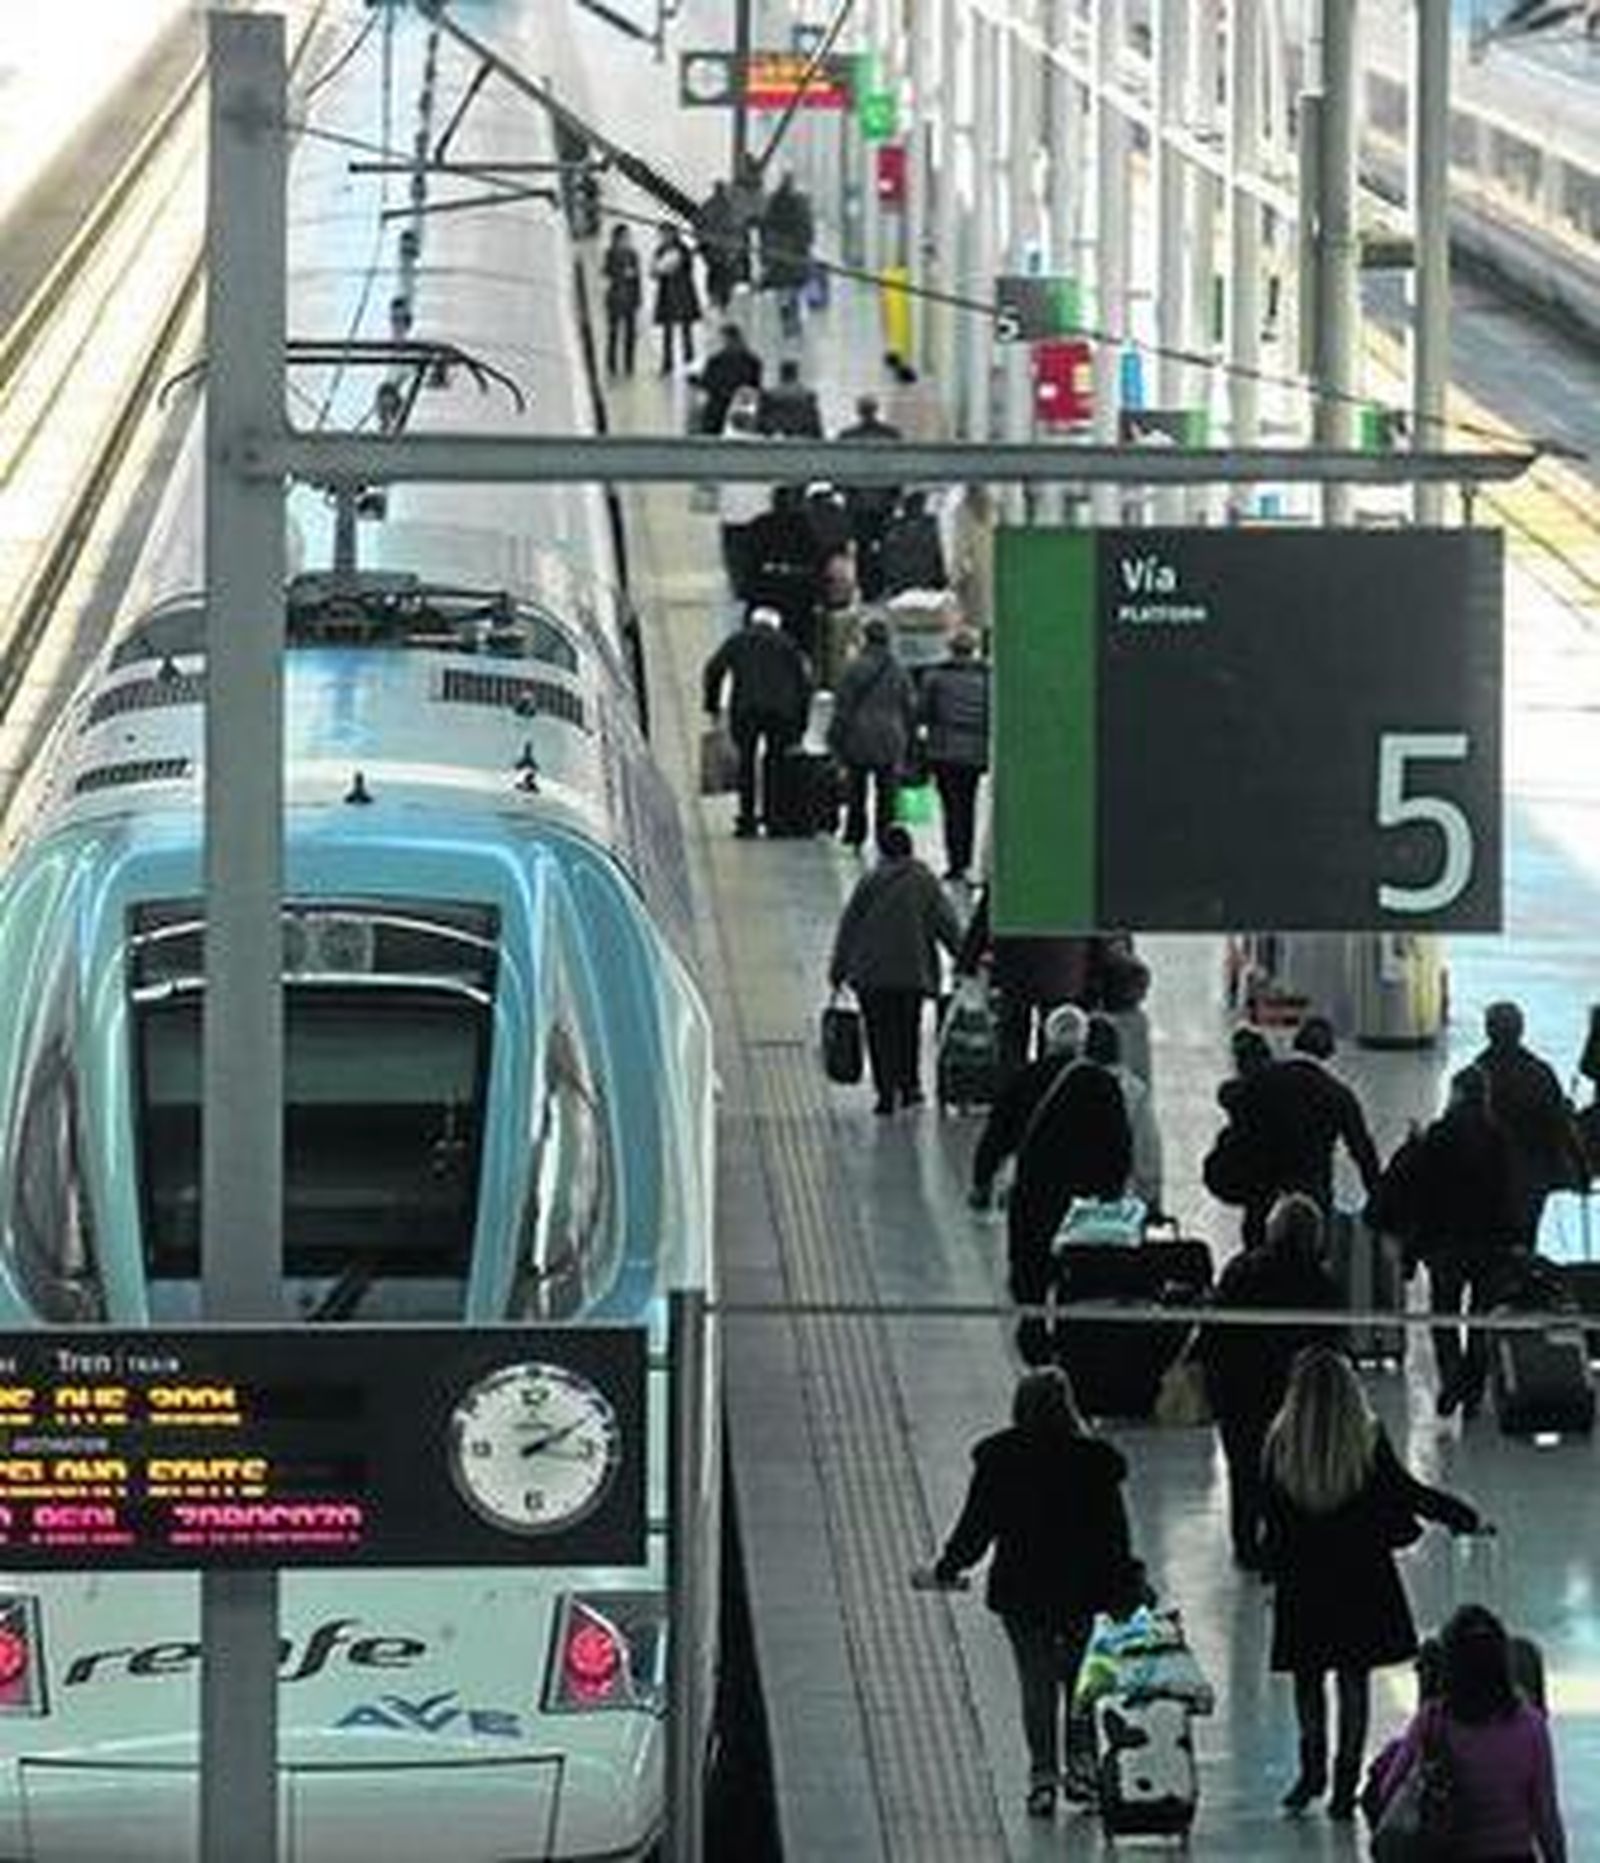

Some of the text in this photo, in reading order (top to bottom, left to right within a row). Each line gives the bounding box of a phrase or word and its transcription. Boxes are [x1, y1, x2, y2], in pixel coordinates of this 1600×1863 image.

[1121, 554, 1177, 593] Vía
[1377, 731, 1475, 914] 5
[64, 1618, 426, 1686] refe
[335, 1689, 523, 1739] AVE
